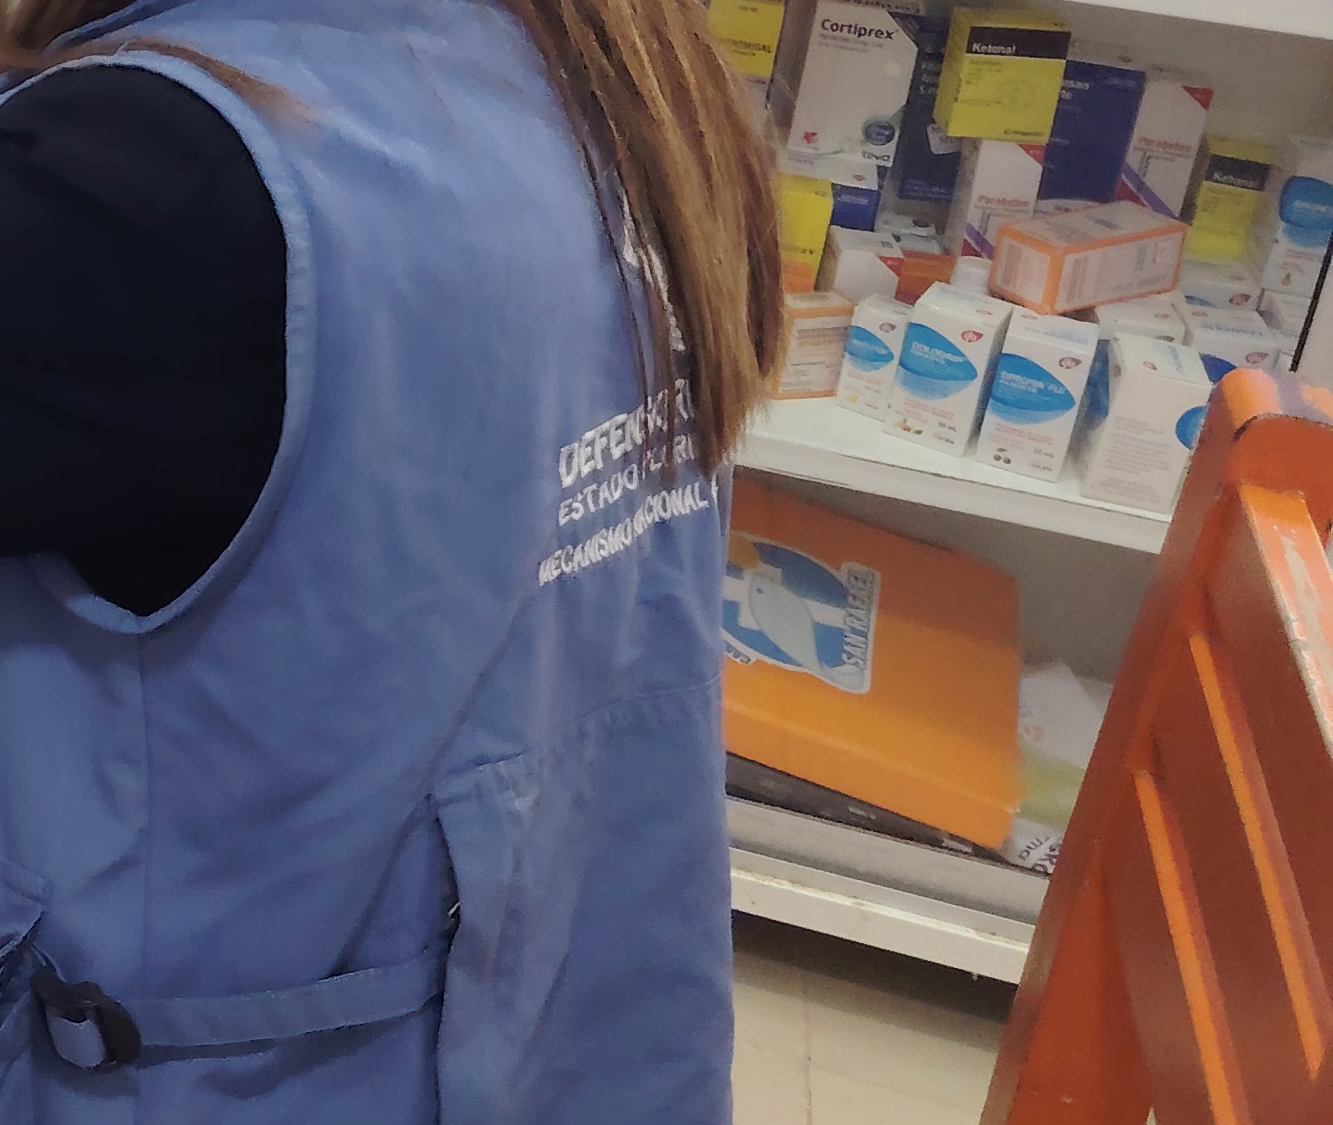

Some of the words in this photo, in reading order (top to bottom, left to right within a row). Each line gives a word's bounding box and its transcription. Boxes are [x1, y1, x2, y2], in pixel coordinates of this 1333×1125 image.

[821, 18, 896, 41] Cortiprex
[558, 463, 639, 527] ESTADO
[537, 517, 633, 587] MECANISMO
[842, 630, 868, 668] SAN
